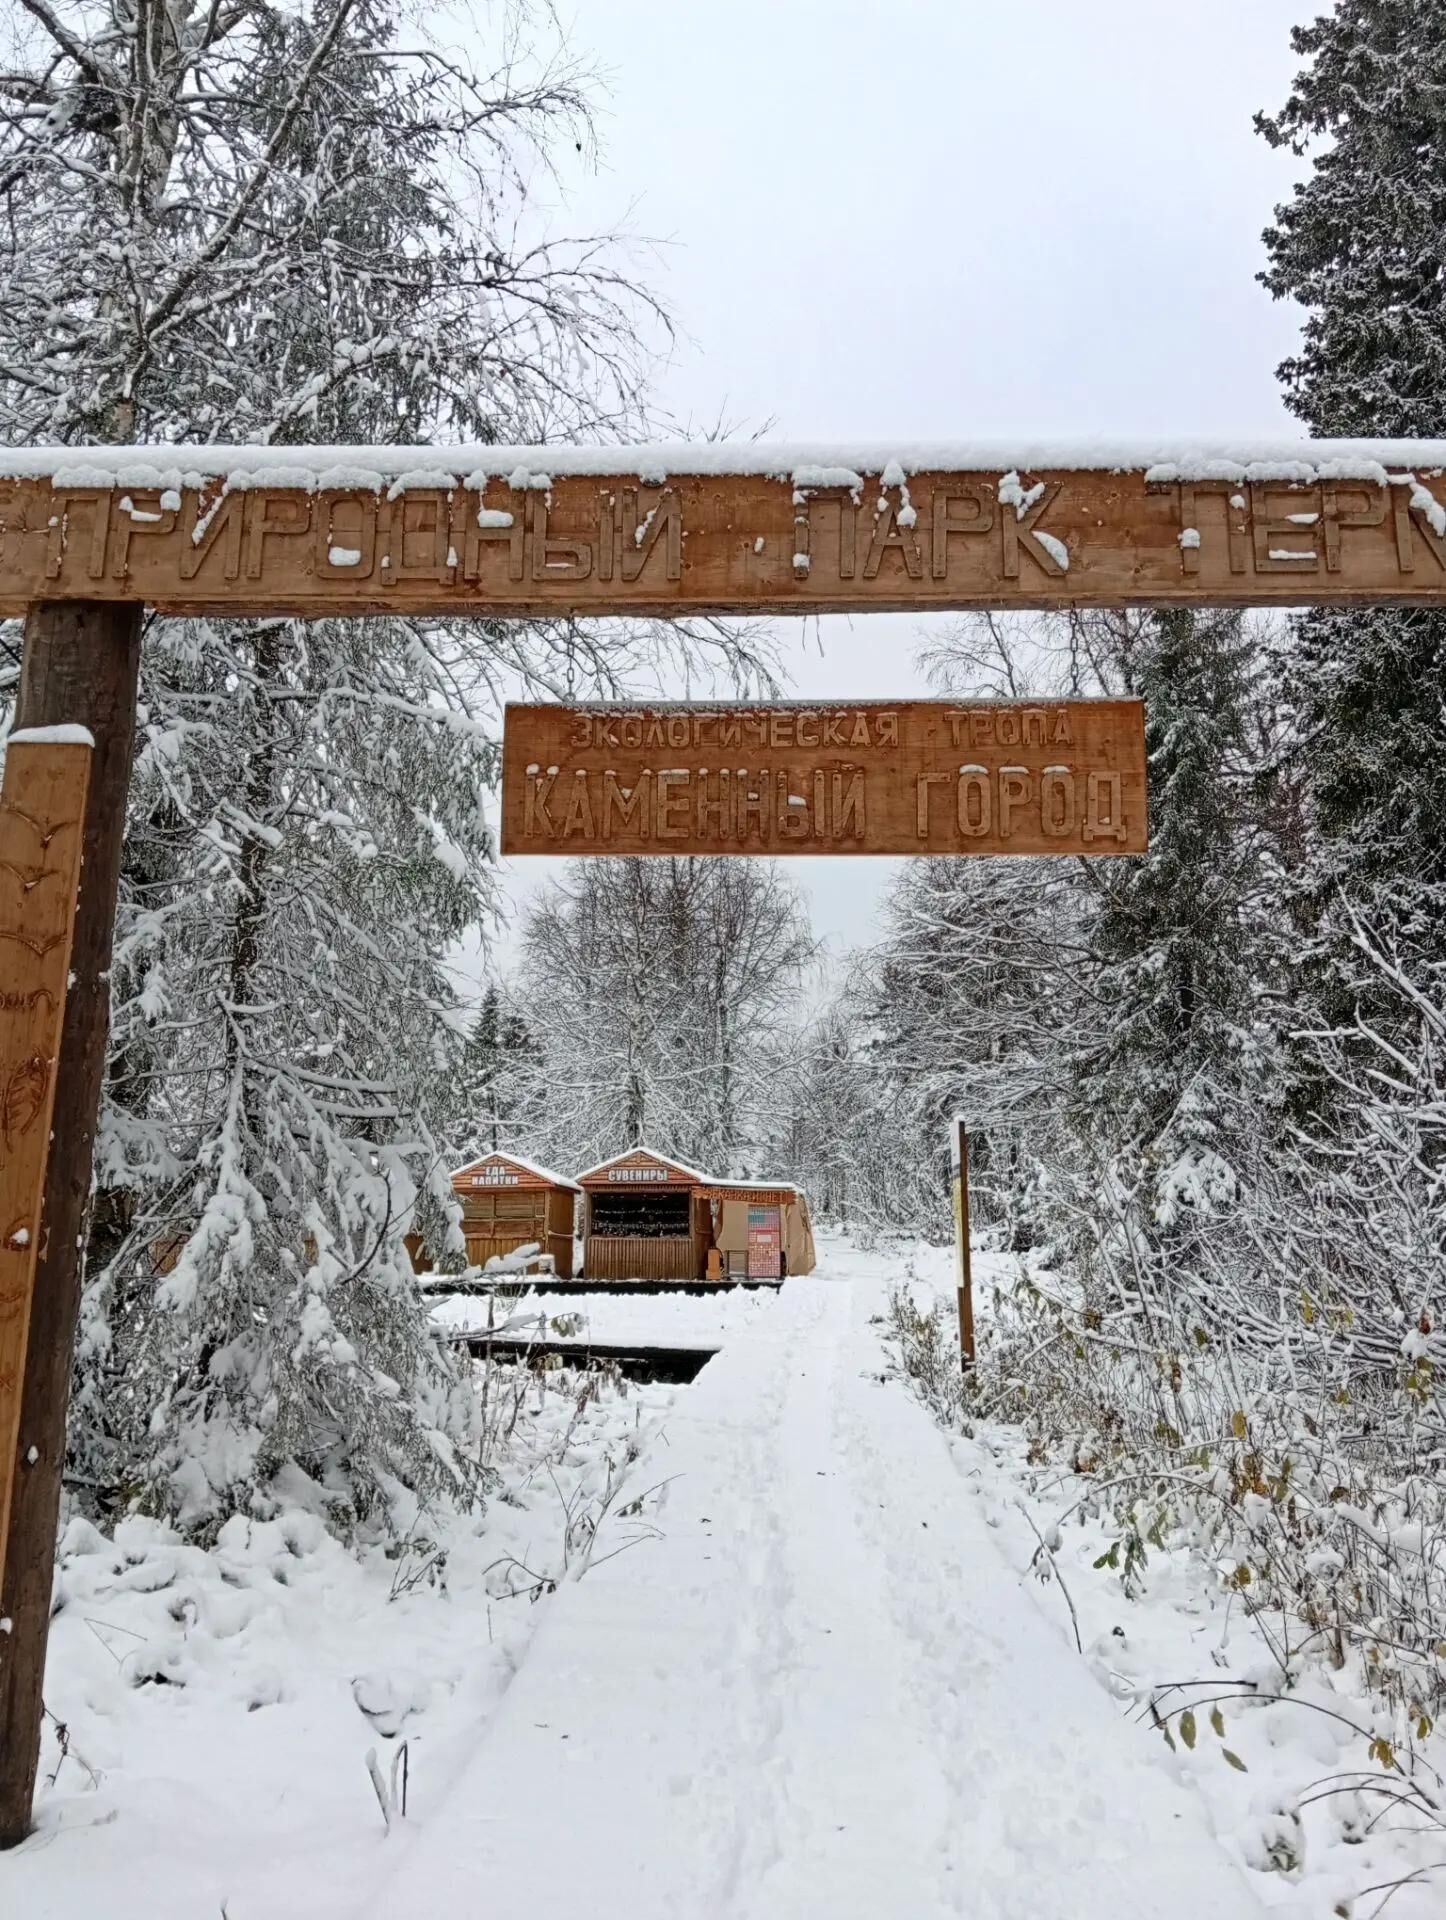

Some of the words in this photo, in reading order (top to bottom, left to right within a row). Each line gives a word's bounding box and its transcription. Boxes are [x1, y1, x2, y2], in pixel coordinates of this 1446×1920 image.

[45, 483, 682, 585] ПРИРОДНЫЙ
[793, 482, 1070, 580] ПАРК
[571, 712, 899, 748] ЭКОЛОГИЧЕСКАЯ
[943, 709, 1074, 745] ТРОПА
[523, 766, 867, 842] КАМЕННЫЙ
[916, 766, 1128, 841] ГОРОД
[471, 1175, 519, 1186] НАПИТКИ
[485, 1166, 506, 1176] ЕДА
[607, 1169, 669, 1181] СУВЕНИРЫ
